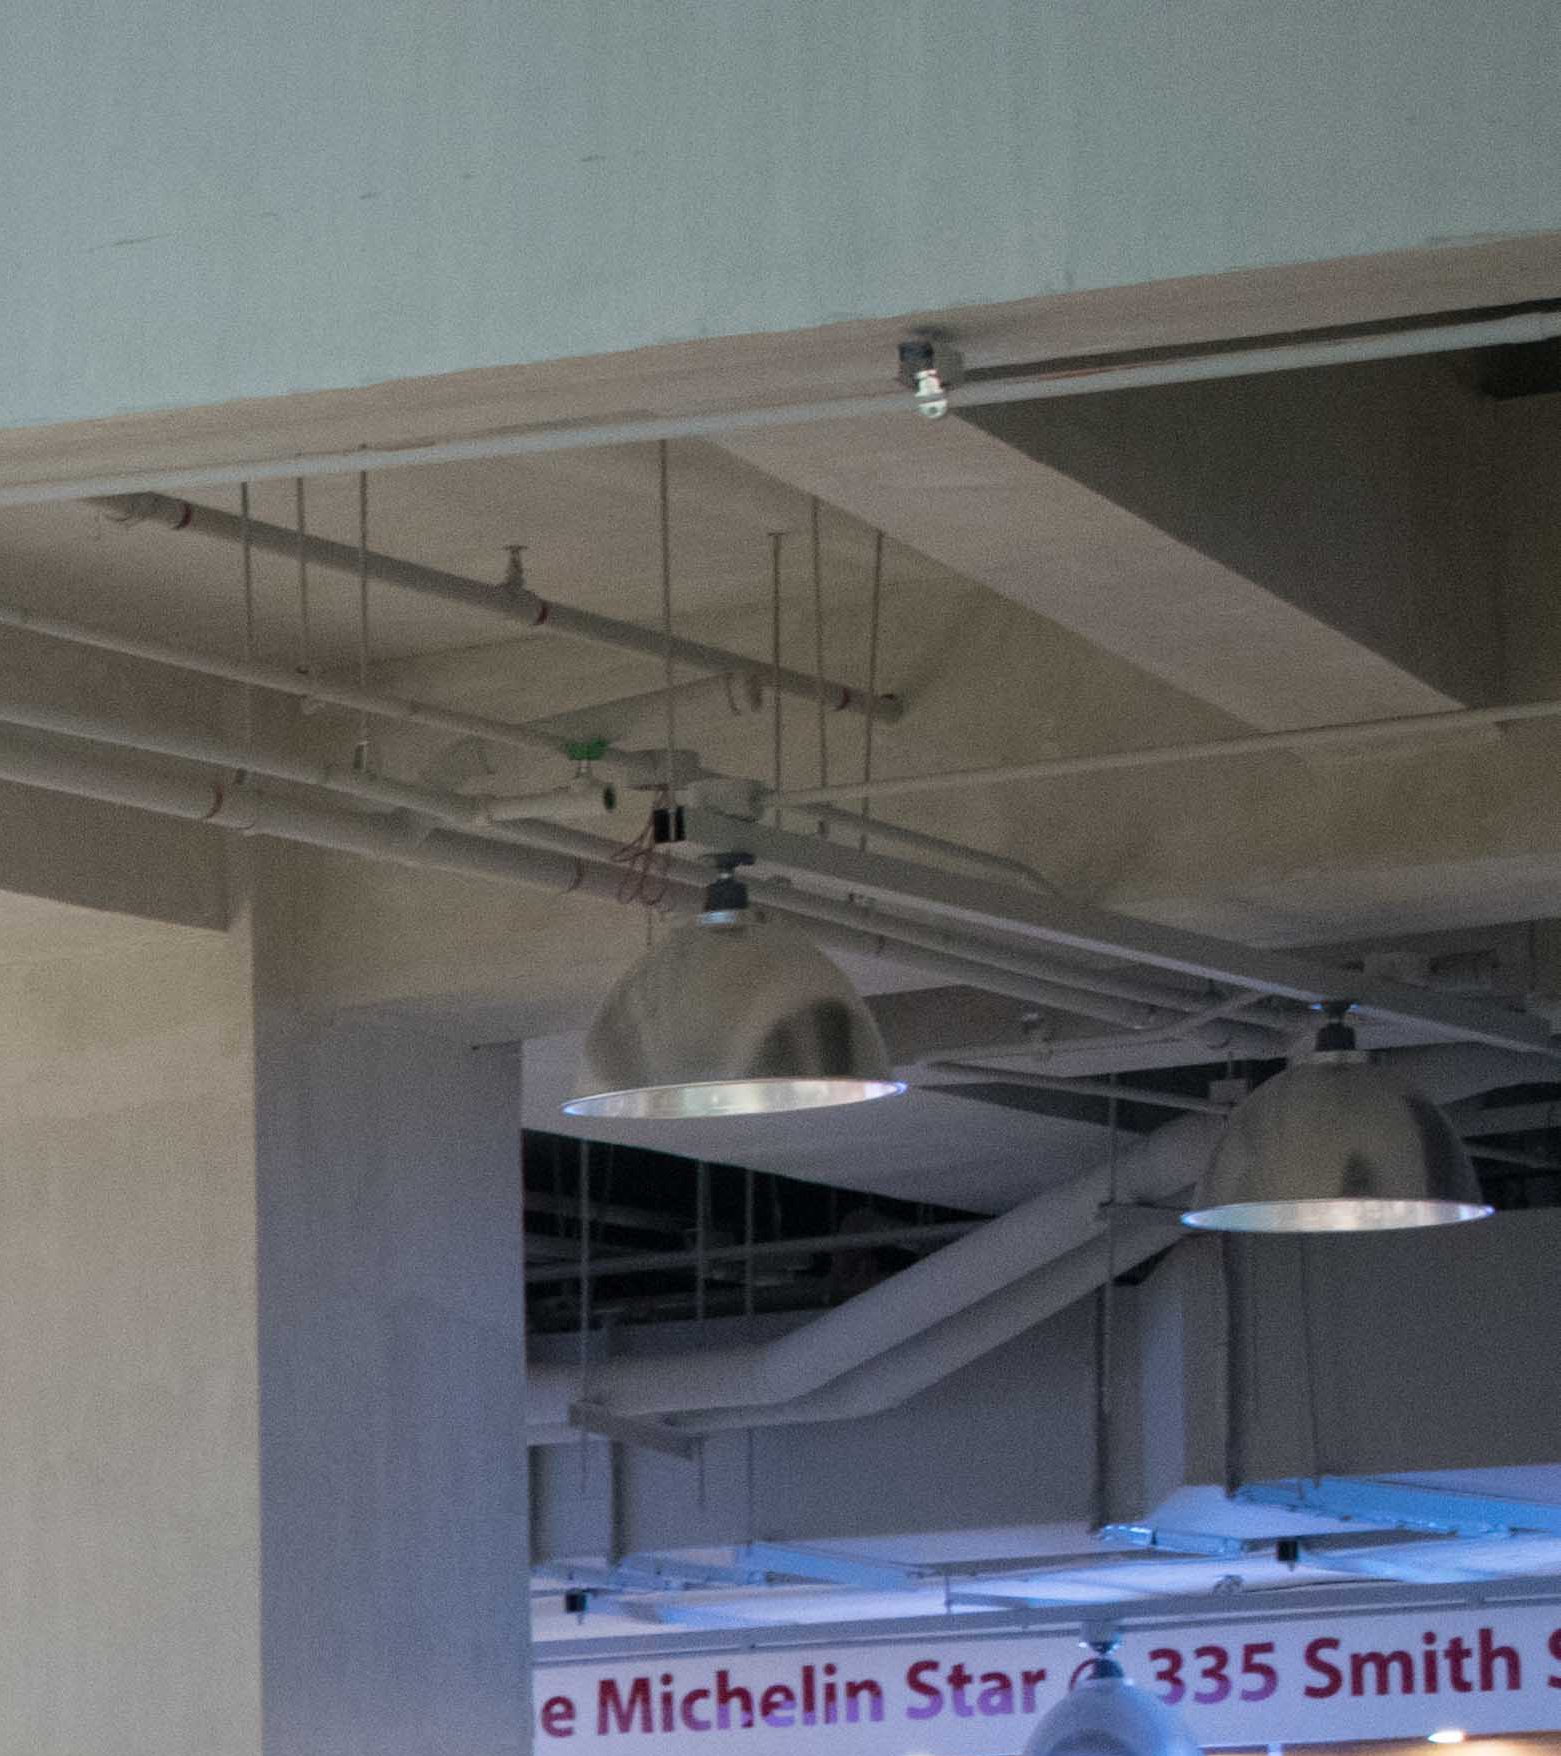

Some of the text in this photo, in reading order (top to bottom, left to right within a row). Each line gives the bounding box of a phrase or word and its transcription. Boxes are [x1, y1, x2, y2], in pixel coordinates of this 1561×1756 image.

[596, 1662, 884, 1737] Michelin
[905, 1659, 1046, 1721] Star
[1148, 1641, 1278, 1706] 335
[1303, 1628, 1523, 1700] Smith
